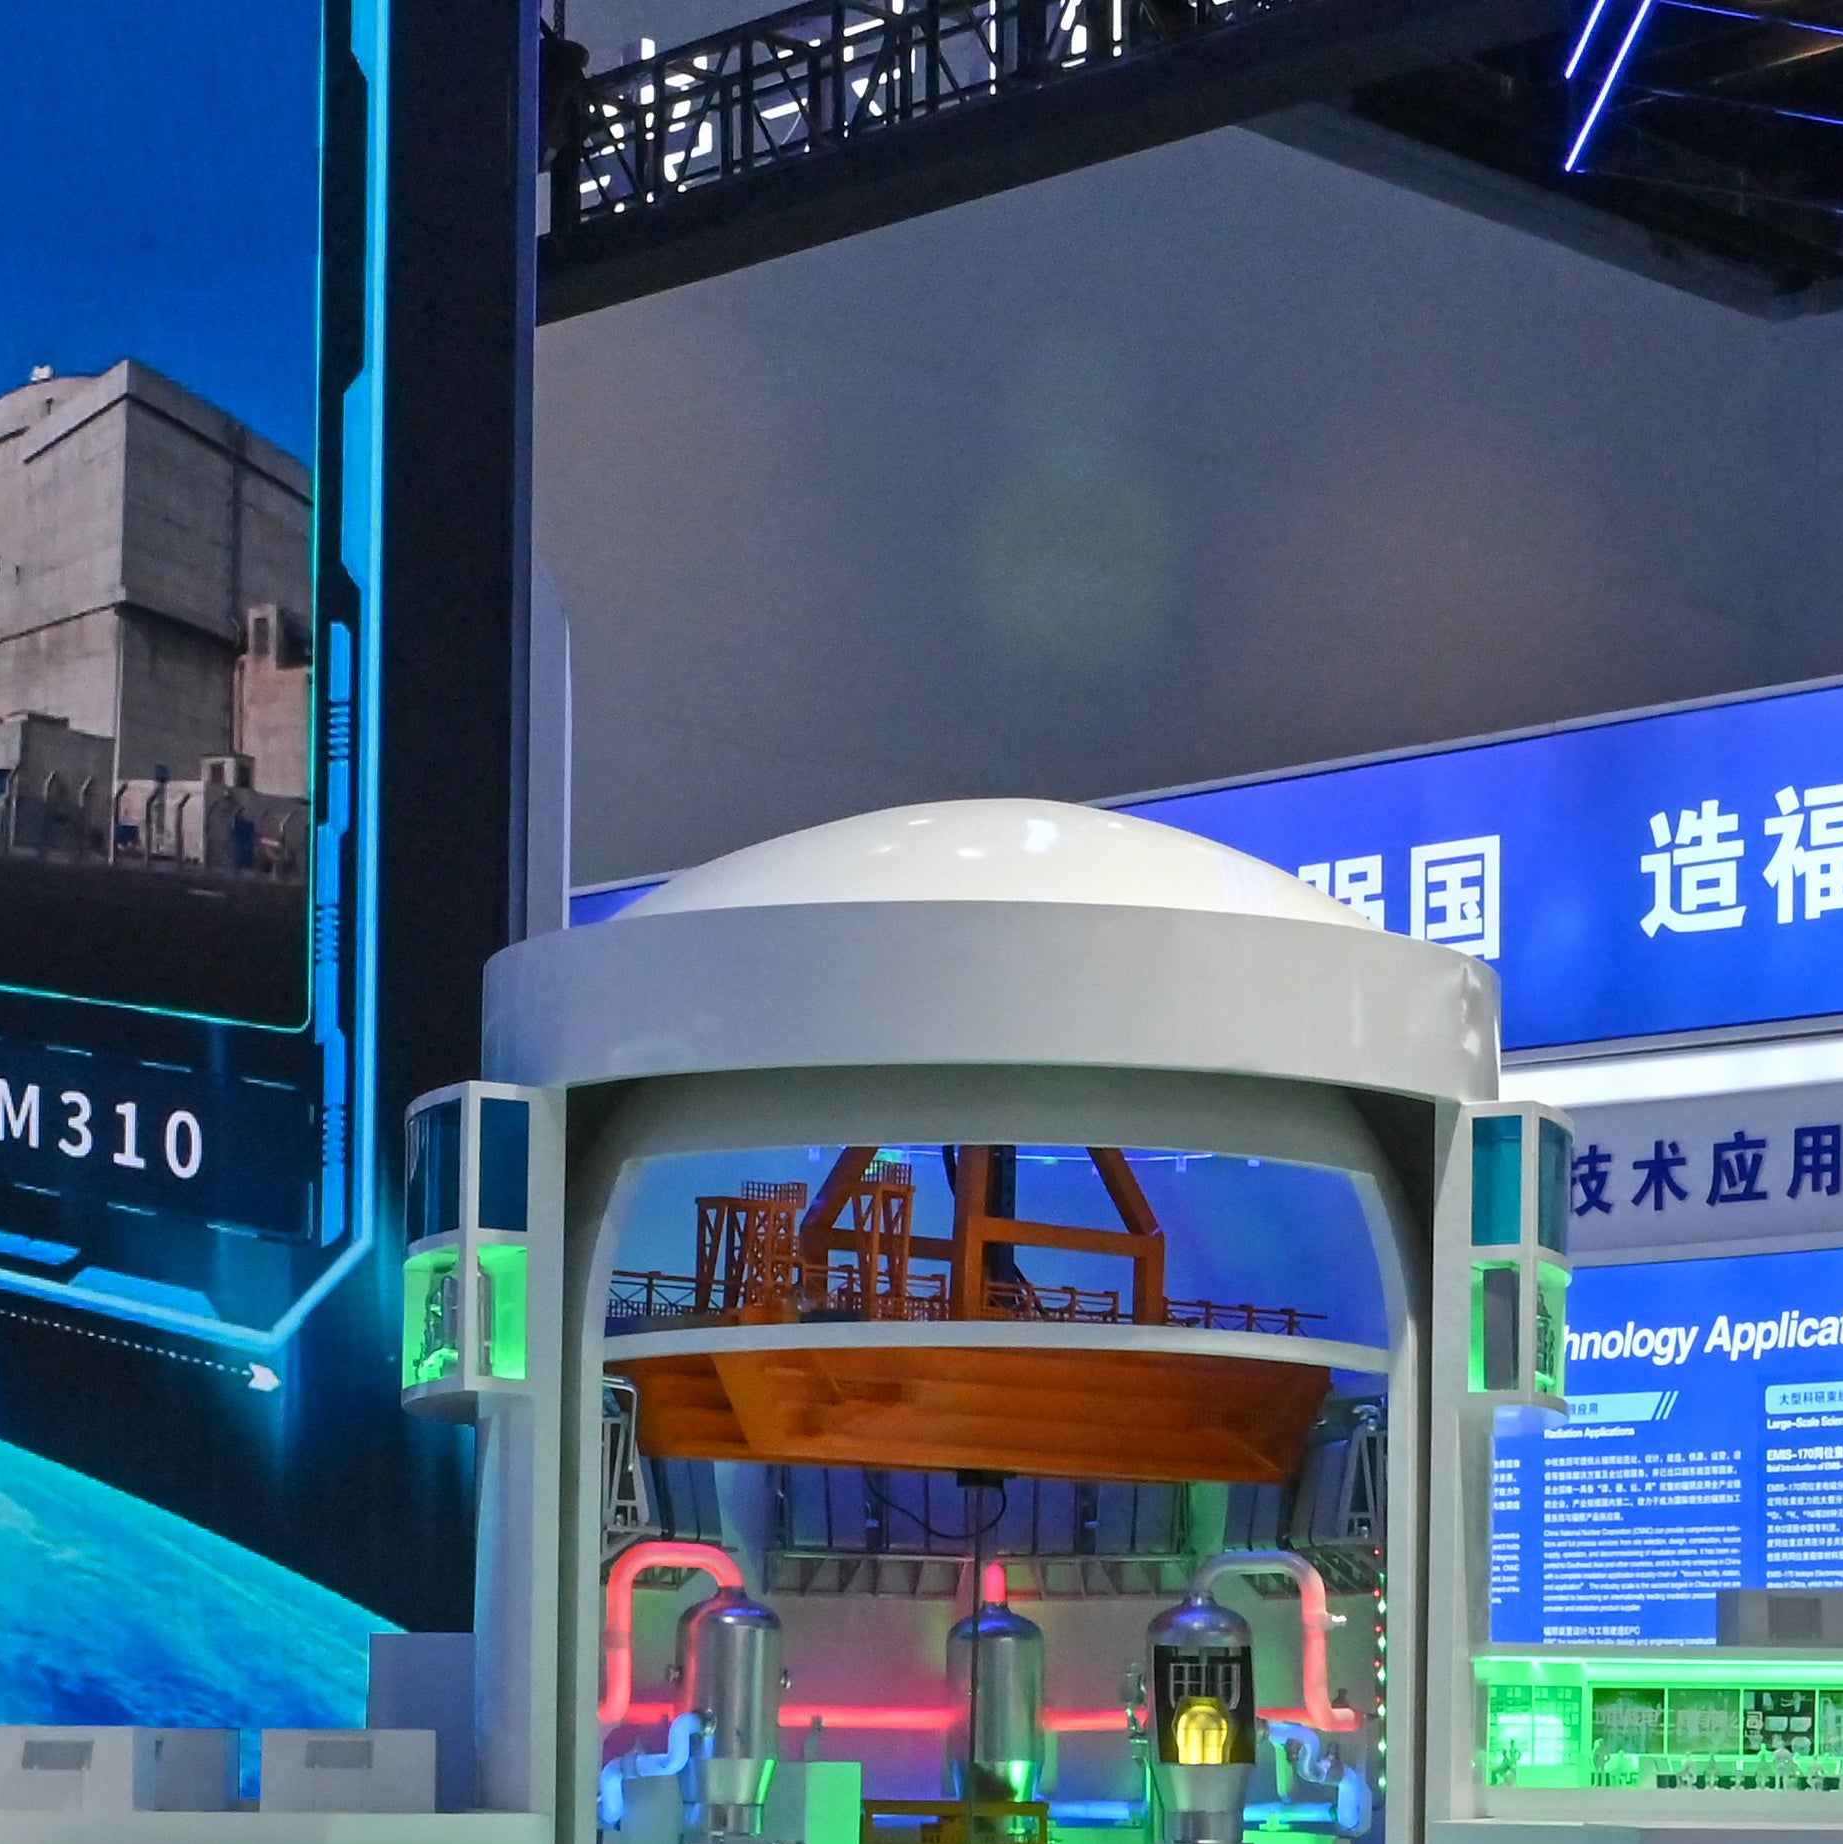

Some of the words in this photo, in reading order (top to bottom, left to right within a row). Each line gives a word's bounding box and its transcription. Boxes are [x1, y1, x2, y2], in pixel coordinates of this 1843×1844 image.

[1571, 1124, 1842, 1216] 技术应用
[1767, 1416, 1819, 1429] Large-Scale
[1544, 1428, 1582, 1437] Radiation
[1584, 1426, 1635, 1437] Applications
